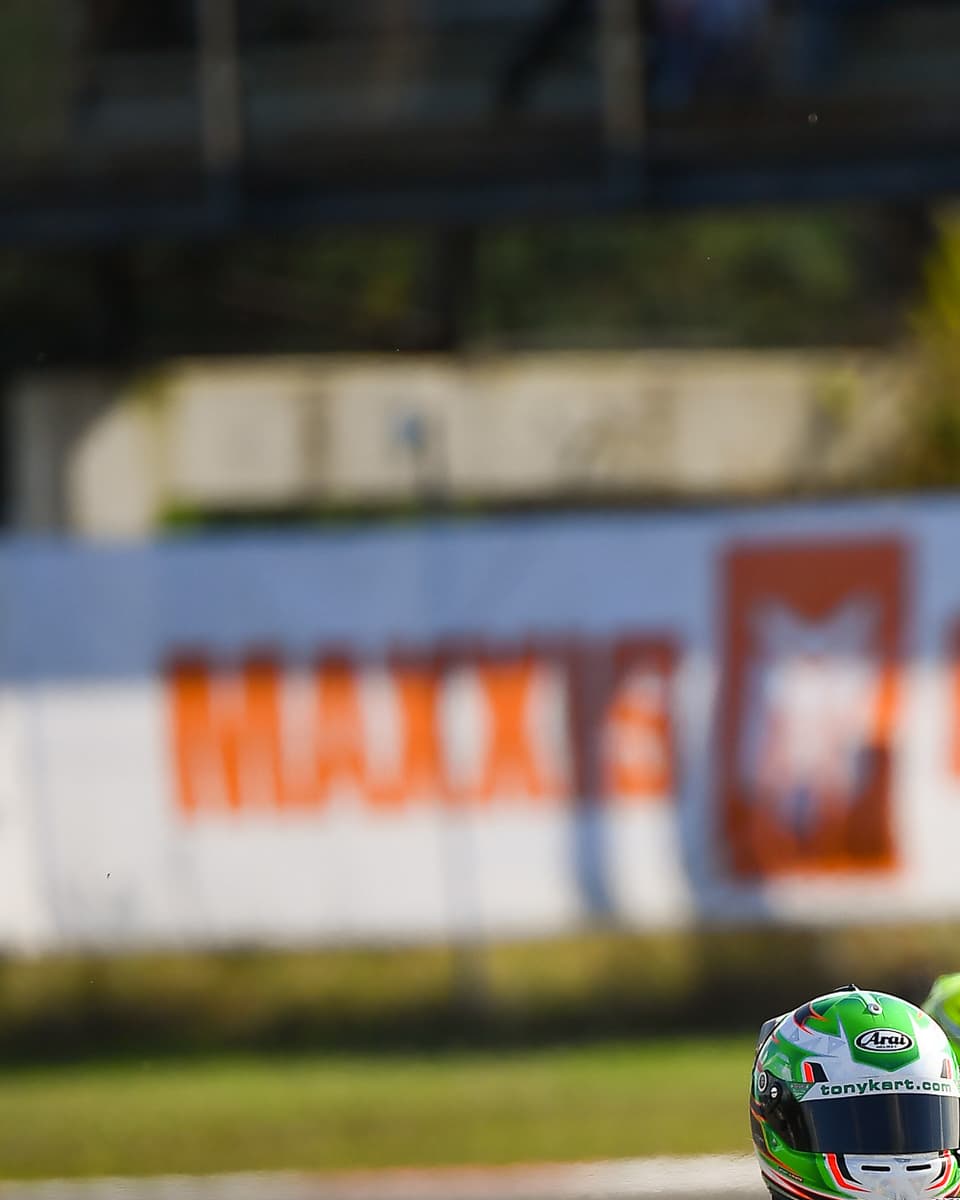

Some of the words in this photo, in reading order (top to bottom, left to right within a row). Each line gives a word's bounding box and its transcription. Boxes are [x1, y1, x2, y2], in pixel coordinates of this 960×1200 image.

[160, 635, 684, 816] MAXXIS
[861, 1031, 906, 1046] Arai
[820, 1079, 952, 1096] tonykart.com
